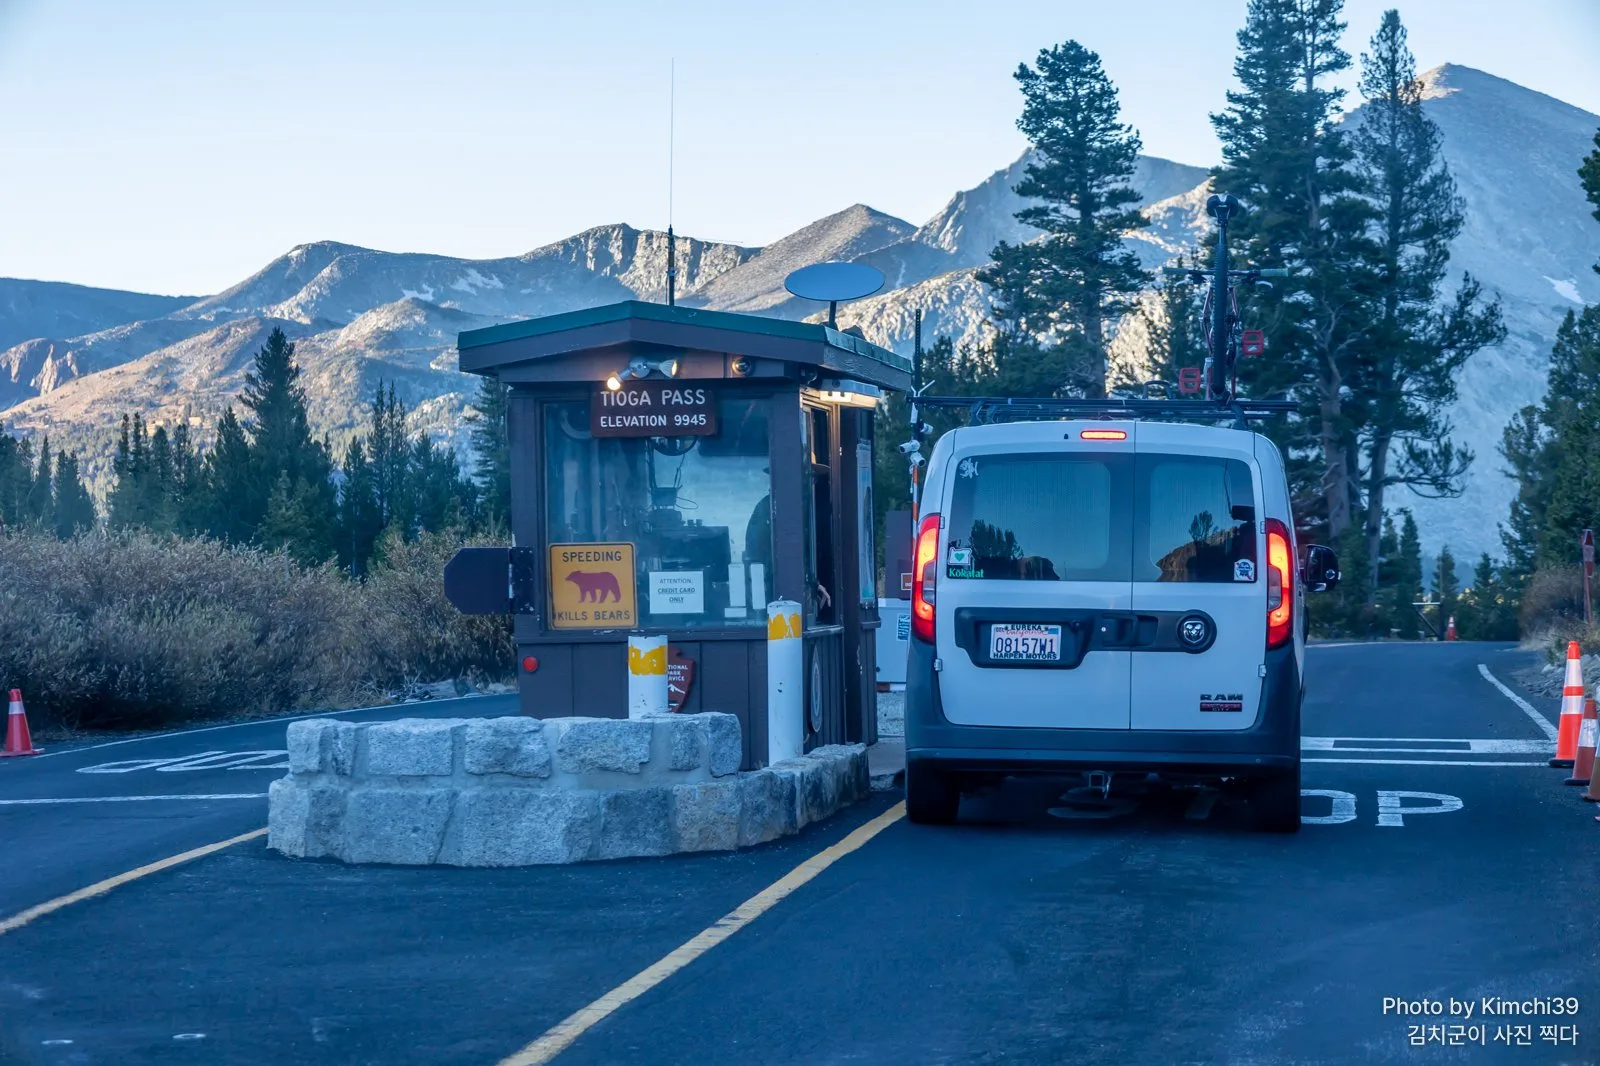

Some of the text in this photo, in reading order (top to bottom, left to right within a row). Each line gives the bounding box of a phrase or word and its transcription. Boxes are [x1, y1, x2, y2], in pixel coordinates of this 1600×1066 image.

[600, 389, 706, 407] TIOGA PASS
[600, 414, 706, 427] ELEVATION 9945
[562, 551, 622, 562] SPEEDING
[949, 568, 984, 578] Kokatat
[557, 610, 631, 621] KILLS BEARS
[995, 637, 1056, 654] 08157W1
[1025, 652, 1058, 660] MOTORS
[1200, 693, 1243, 701] RAM
